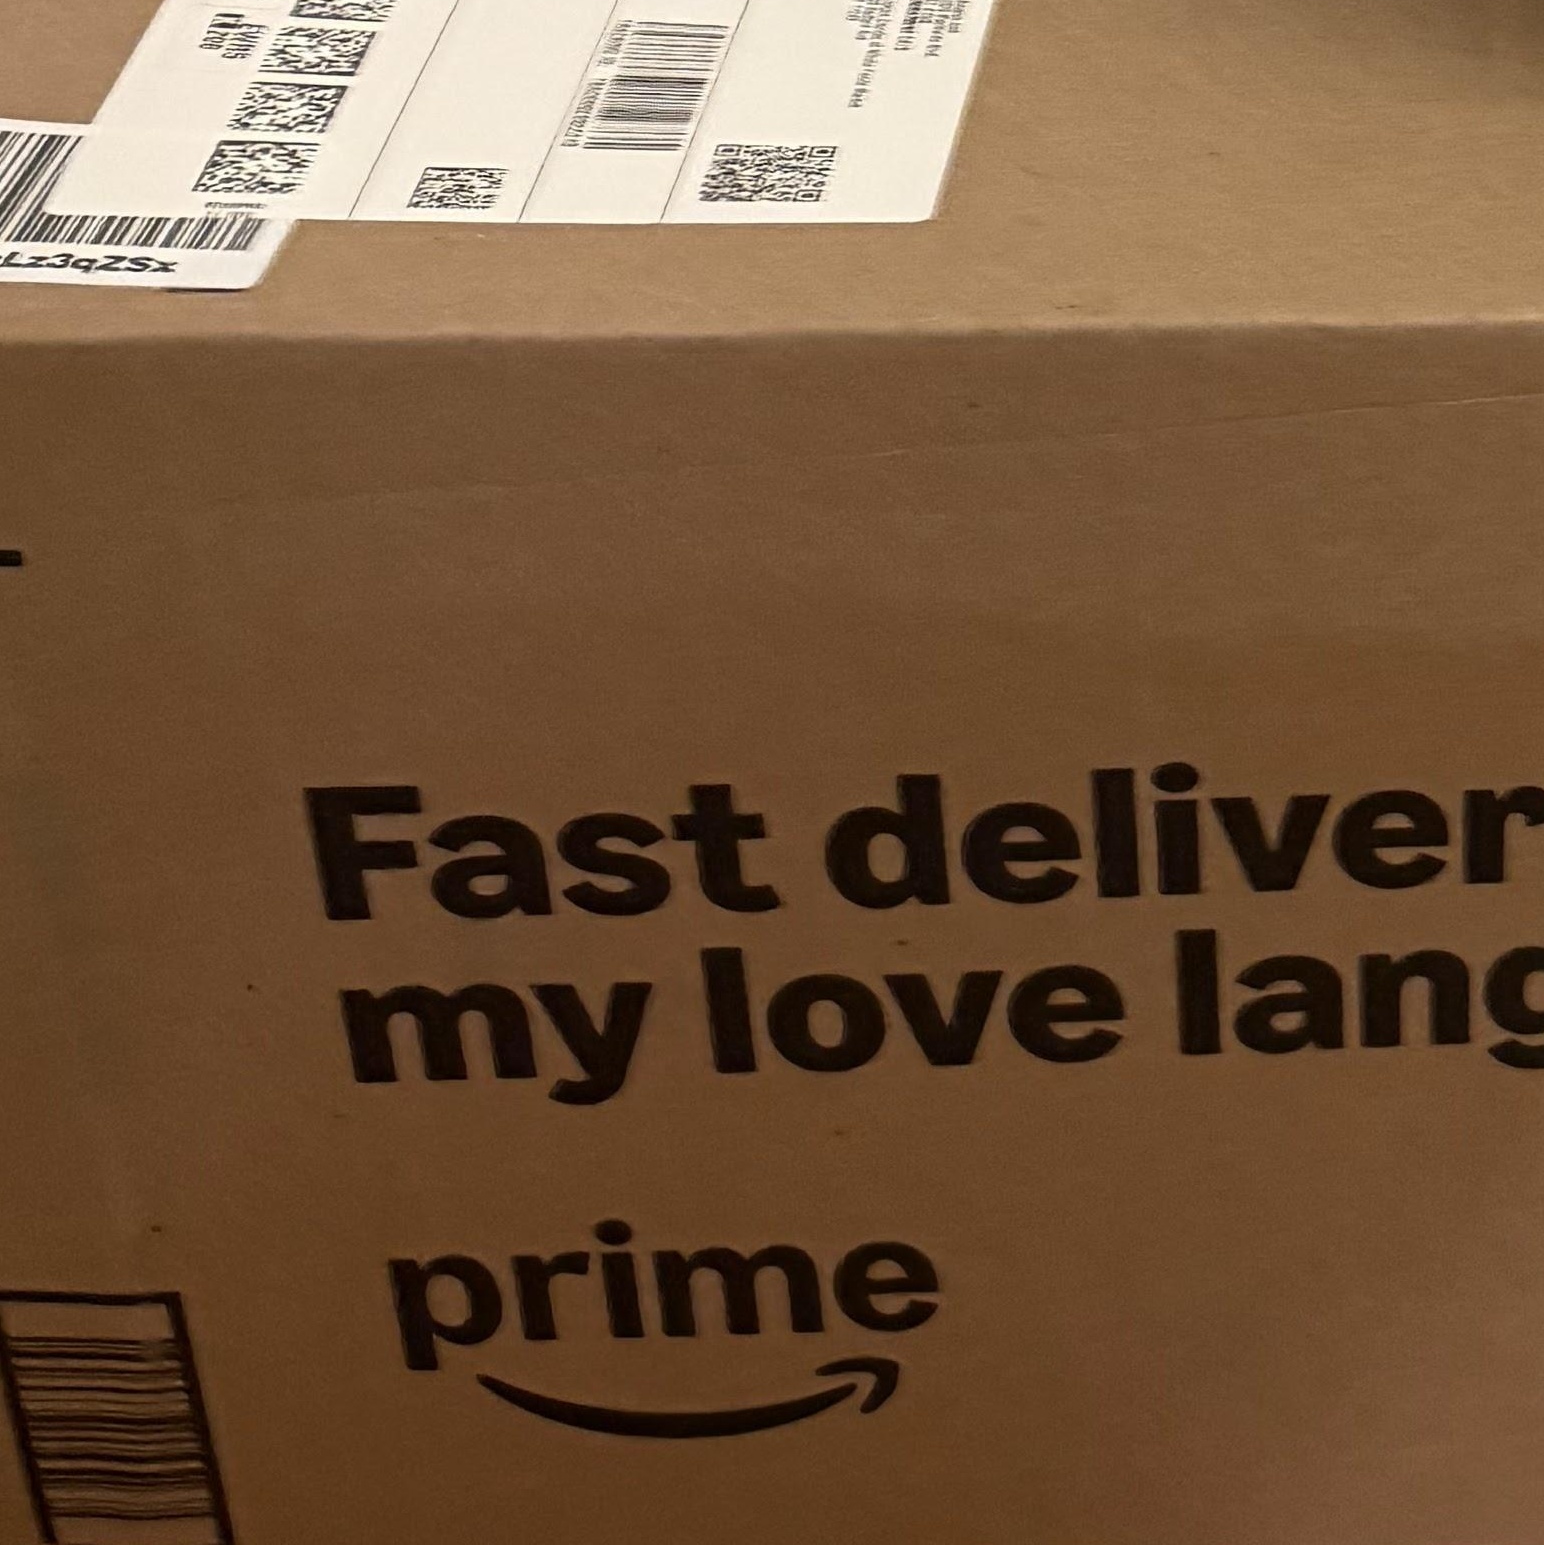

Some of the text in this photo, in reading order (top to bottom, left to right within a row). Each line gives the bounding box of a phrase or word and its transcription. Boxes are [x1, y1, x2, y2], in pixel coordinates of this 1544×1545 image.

[0, 252, 178, 273] Lz3qZSx
[302, 783, 786, 921] Fast
[340, 981, 653, 1106] my
[701, 947, 1127, 1073] love
[388, 1220, 938, 1371] prime
